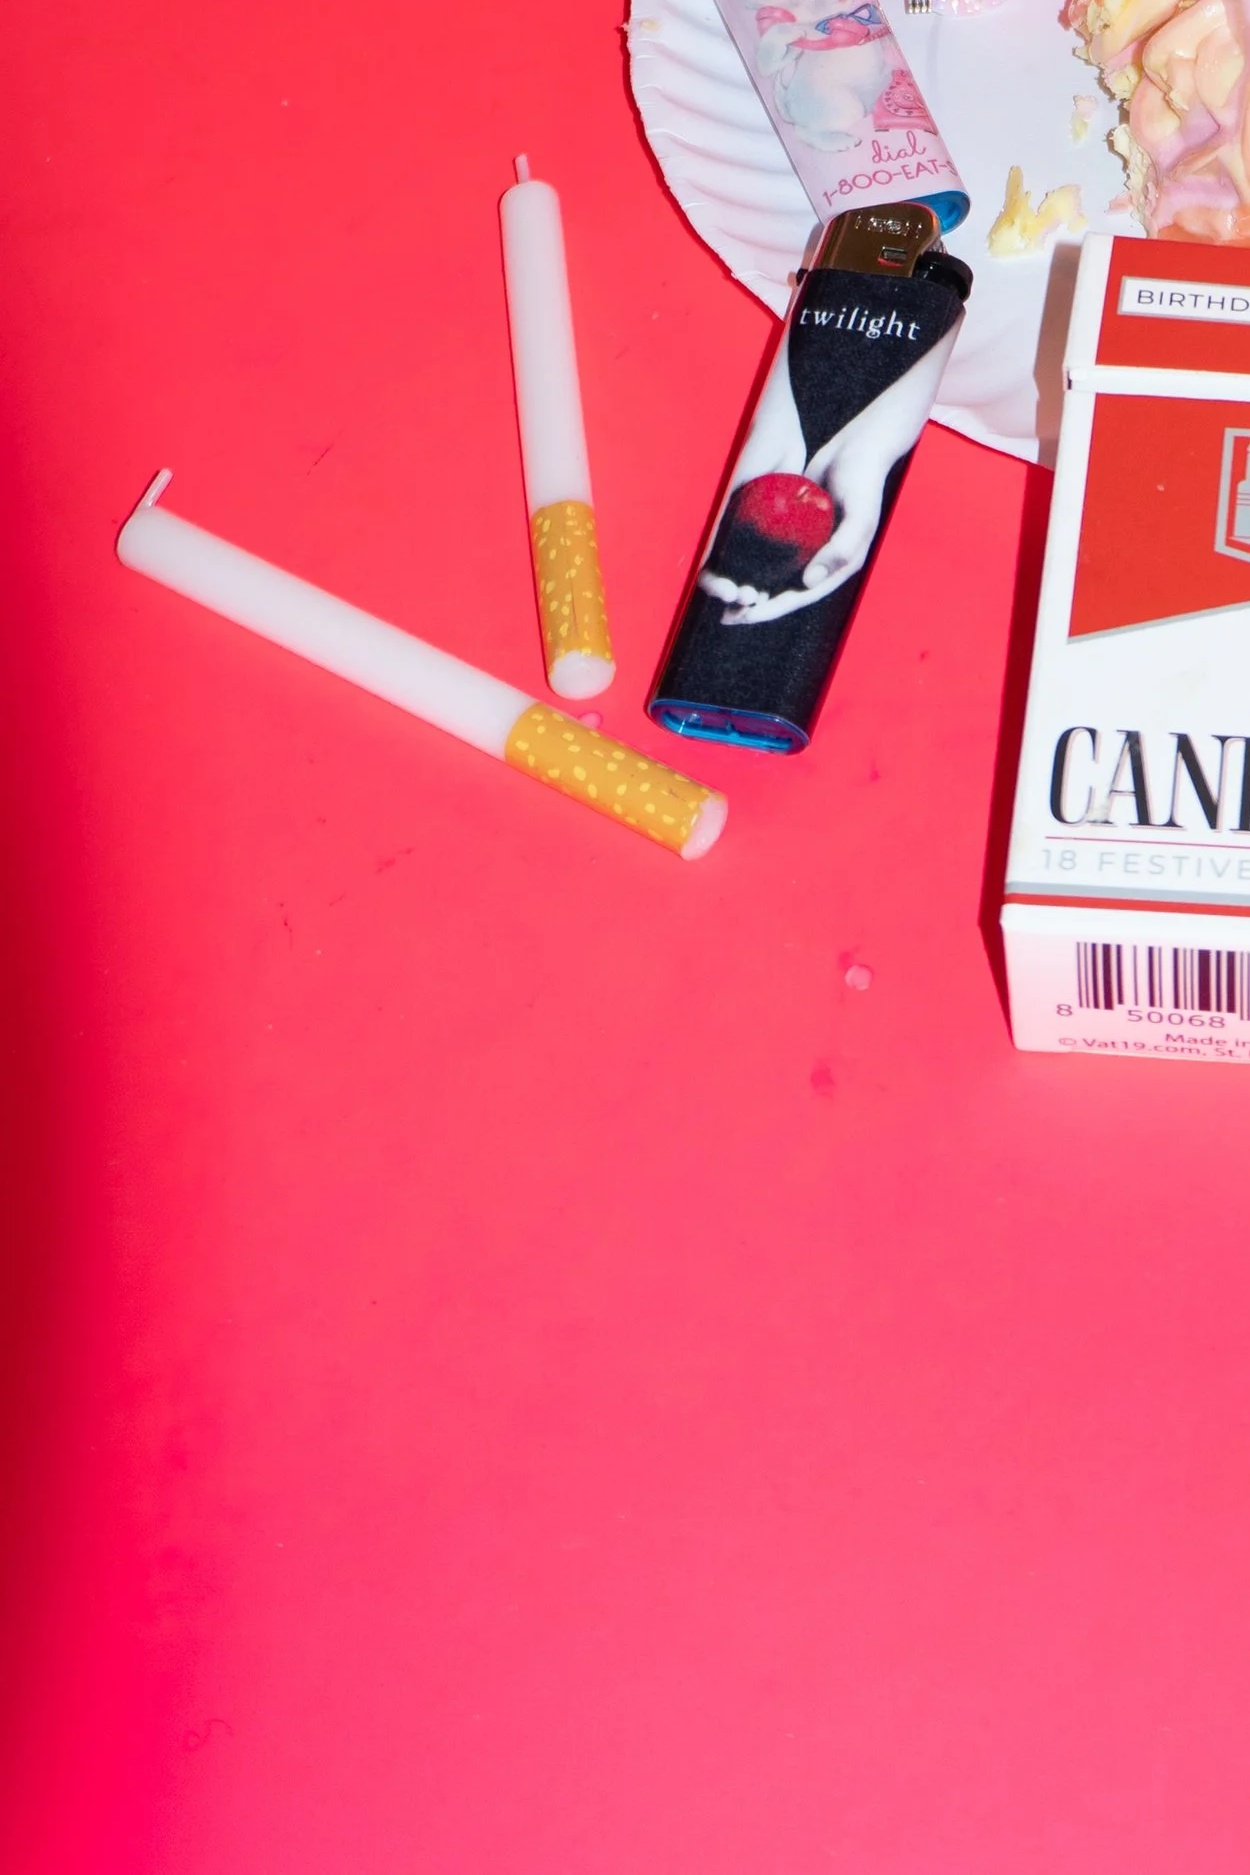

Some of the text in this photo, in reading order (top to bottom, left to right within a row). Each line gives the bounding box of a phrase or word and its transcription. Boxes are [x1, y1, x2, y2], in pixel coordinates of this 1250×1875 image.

[871, 130, 927, 164] dial
[800, 306, 920, 341] twilight
[1041, 848, 1078, 871] 18
[1056, 1003, 1073, 1017] 8
[1127, 1009, 1226, 1029] 50068
[1165, 1033, 1228, 1047] Made
